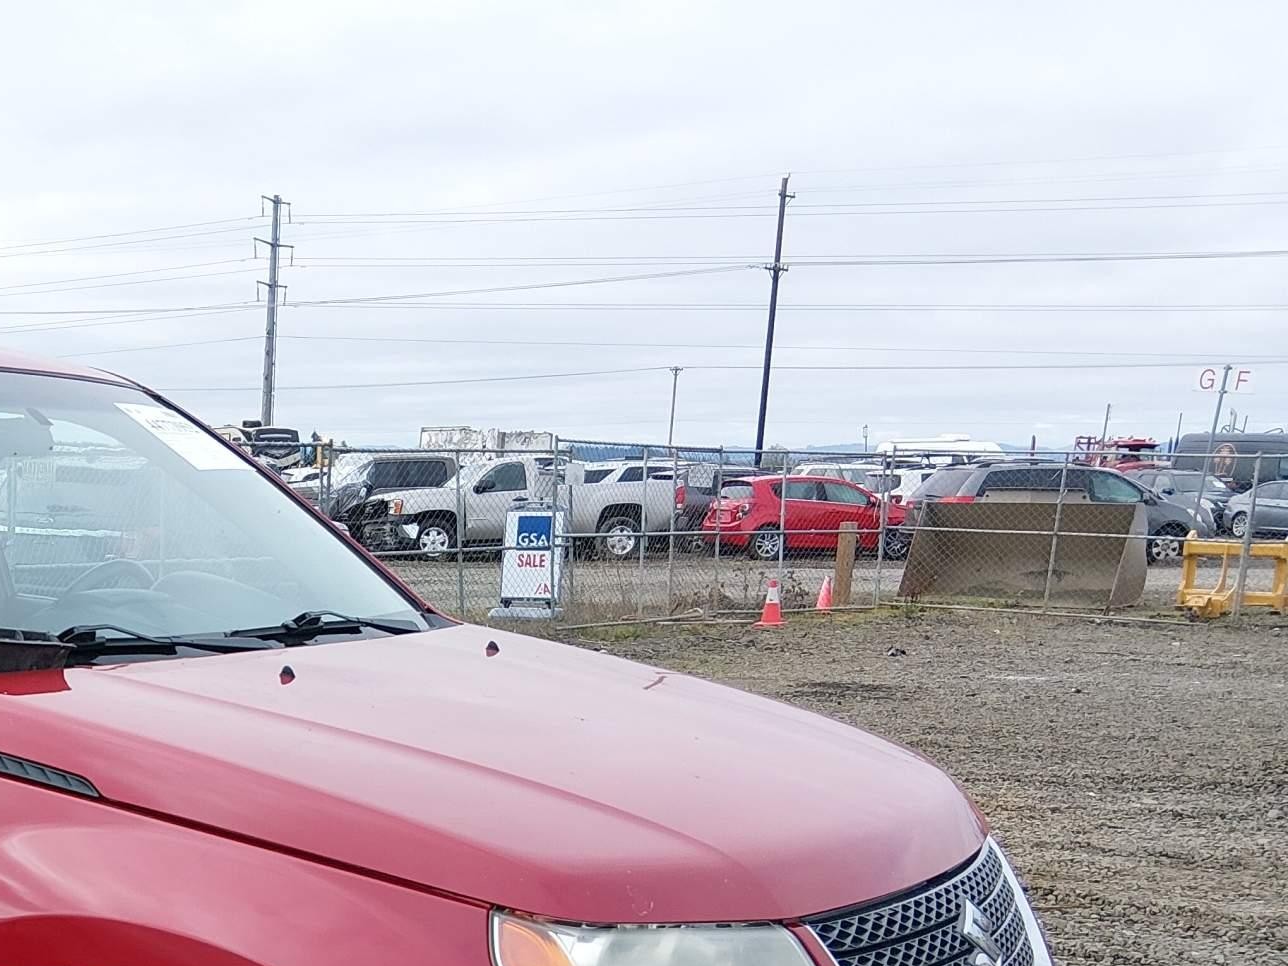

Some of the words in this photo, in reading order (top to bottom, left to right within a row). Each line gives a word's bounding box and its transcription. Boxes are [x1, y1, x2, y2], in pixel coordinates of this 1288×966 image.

[1199, 368, 1217, 390] G
[1235, 371, 1252, 391] F
[518, 533, 548, 546] GSA
[517, 553, 546, 568] SALE
